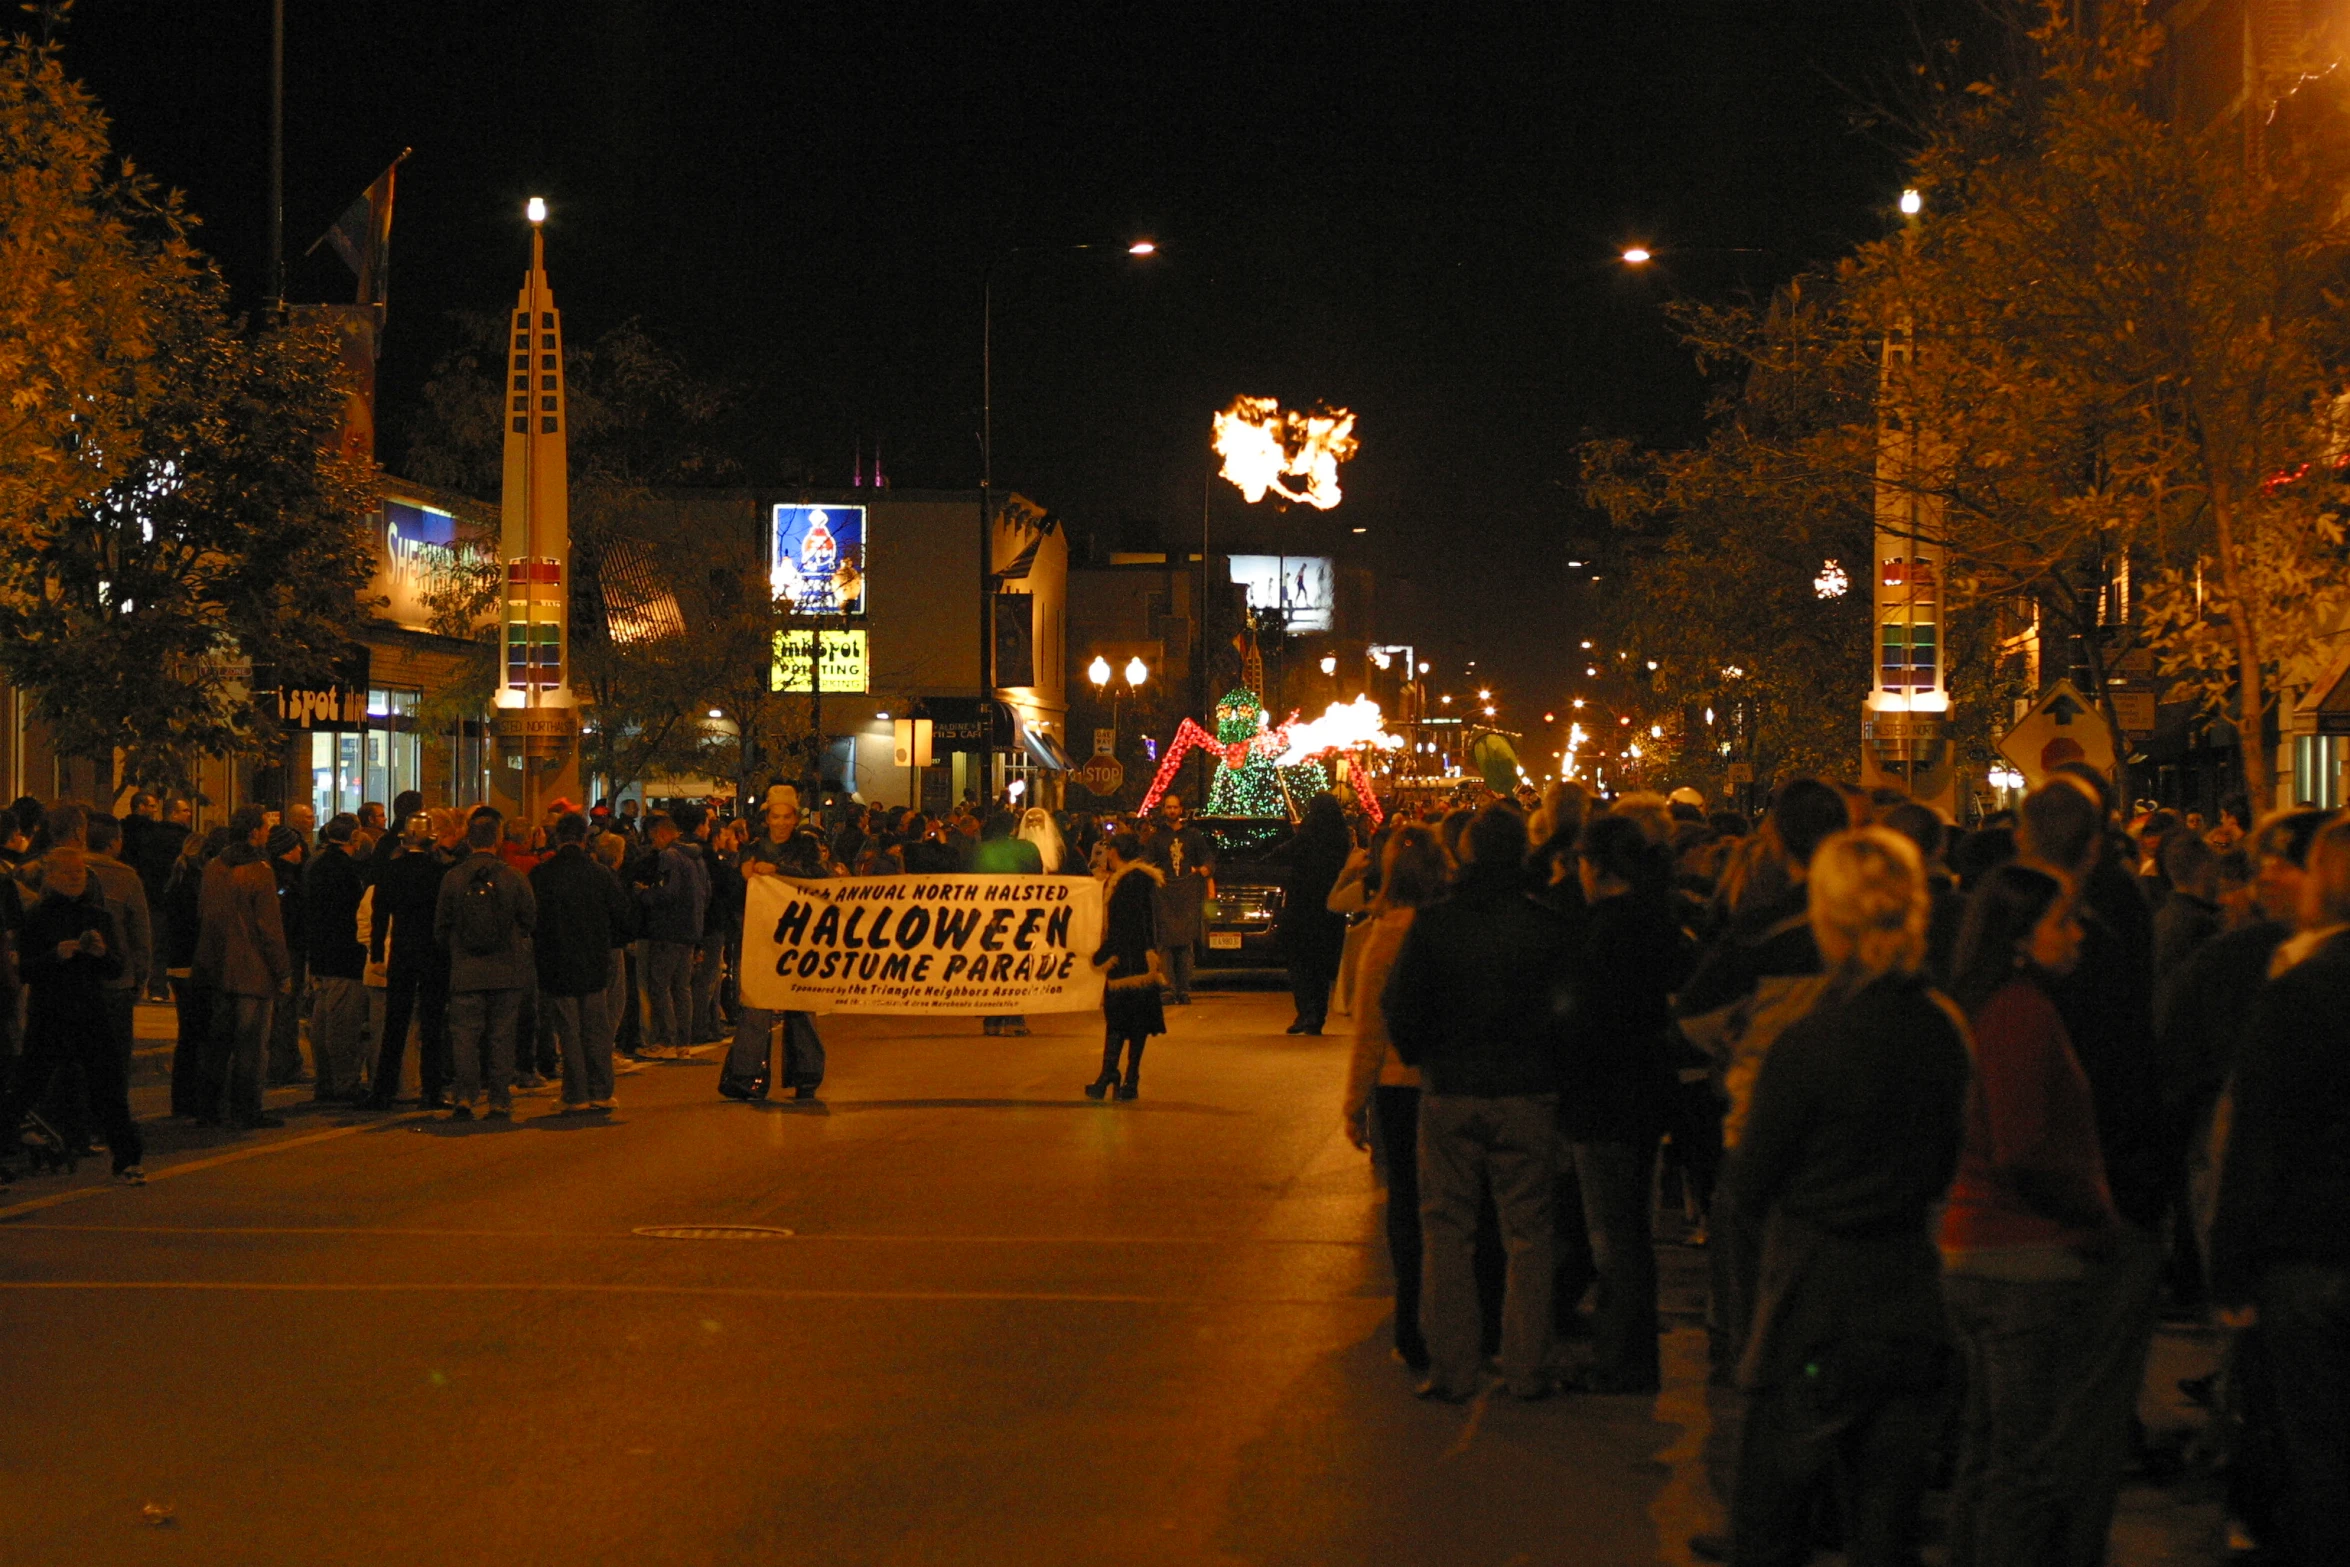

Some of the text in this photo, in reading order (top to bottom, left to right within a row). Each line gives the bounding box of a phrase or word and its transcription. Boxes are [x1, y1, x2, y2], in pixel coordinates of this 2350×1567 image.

[781, 664, 859, 675] PRITING
[1086, 767, 1120, 782] STOP
[835, 884, 906, 903] ANNUAL
[912, 883, 976, 901] NORTH
[984, 883, 1069, 902] HALSTED
[773, 900, 1073, 952] HALLOWEEN
[775, 948, 1076, 982] COSTUME PARADE
[848, 983, 867, 995] the
[870, 983, 921, 999] Triangle
[924, 985, 989, 1000] Neighbors
